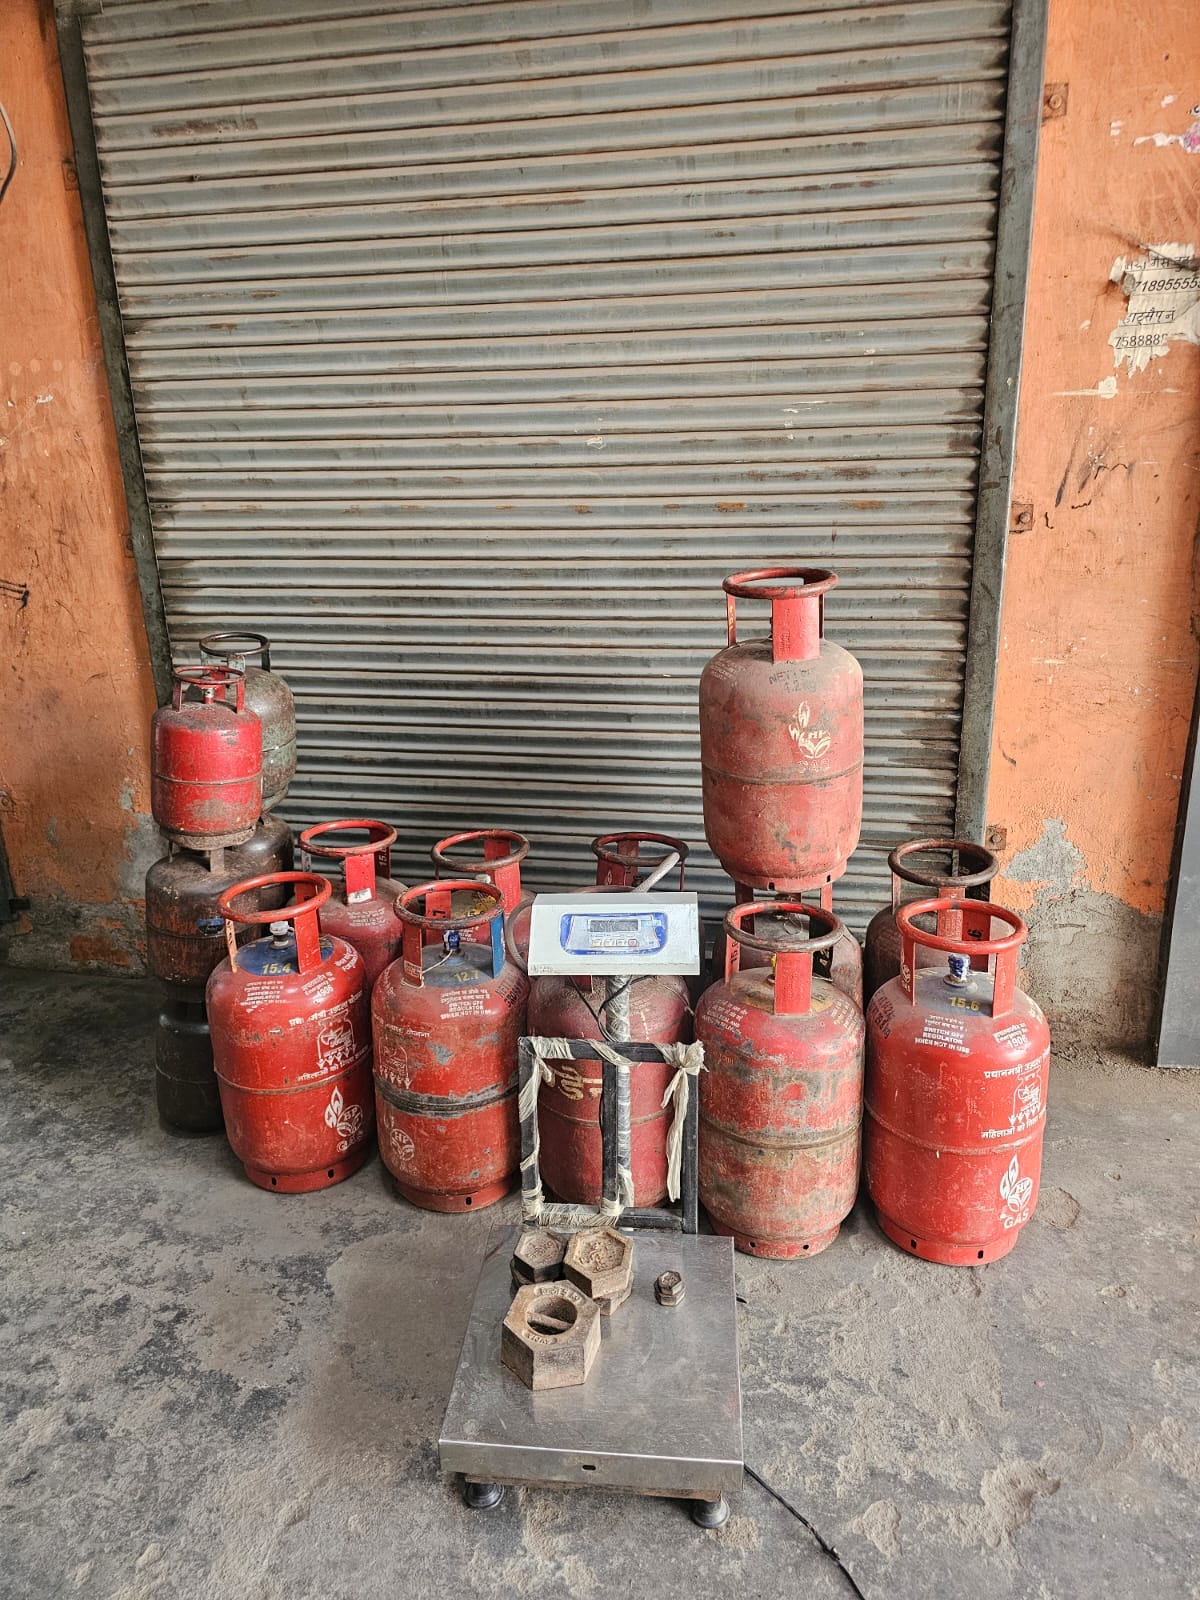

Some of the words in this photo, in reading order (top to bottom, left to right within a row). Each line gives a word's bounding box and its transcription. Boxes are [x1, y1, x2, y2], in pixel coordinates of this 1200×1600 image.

[1136, 276, 1200, 292] 71895555
[262, 963, 292, 975] 15.4
[454, 969, 480, 983] 12.7
[949, 996, 981, 1012] 15.6
[394, 1131, 409, 1144] HP
[1004, 1208, 1029, 1229] GAS
